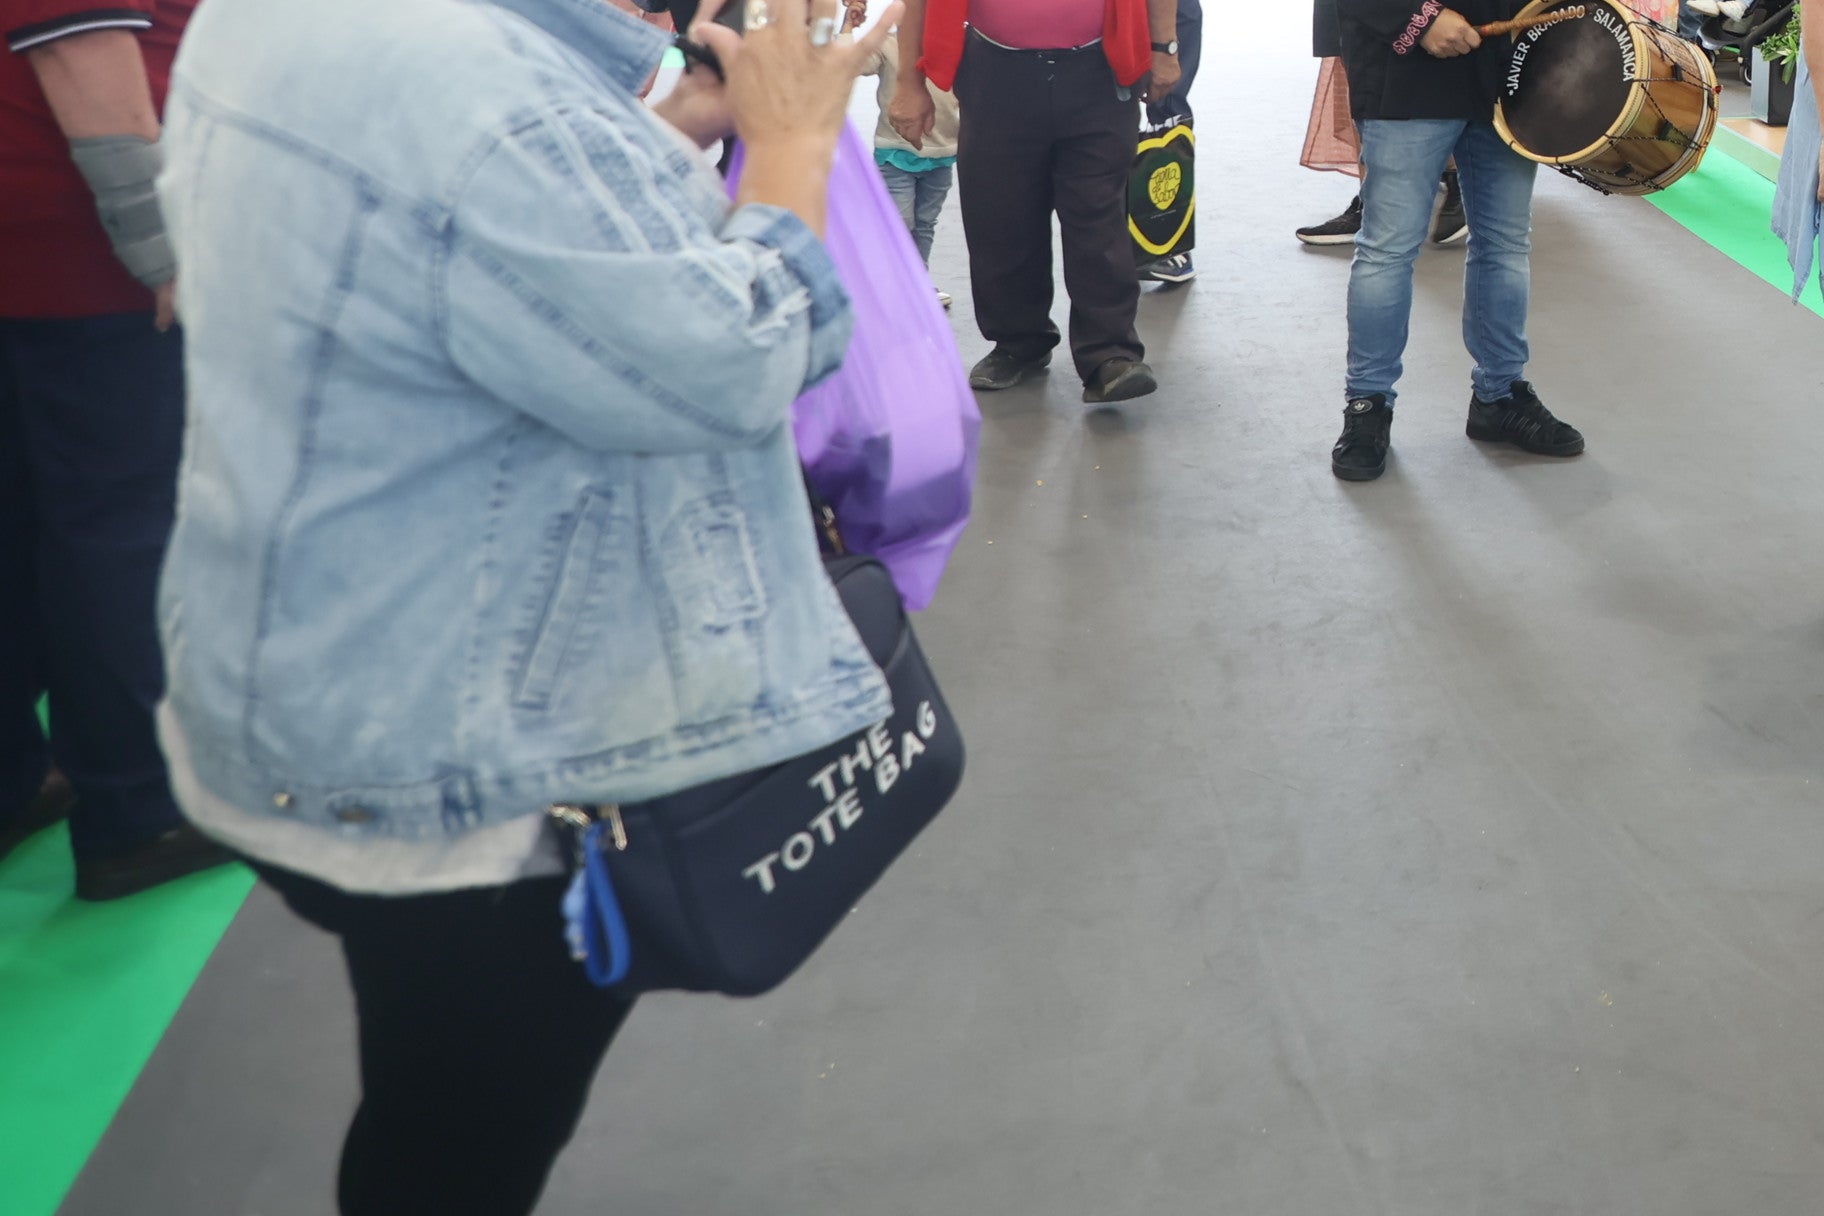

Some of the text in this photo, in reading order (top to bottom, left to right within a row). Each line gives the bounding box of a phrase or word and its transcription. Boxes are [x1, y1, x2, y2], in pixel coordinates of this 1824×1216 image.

[1506, 42, 1530, 91] JAVIER
[1593, 8, 1636, 82] SALAMANCA
[741, 700, 937, 894] TOTE BAG
[807, 718, 894, 802] THE
